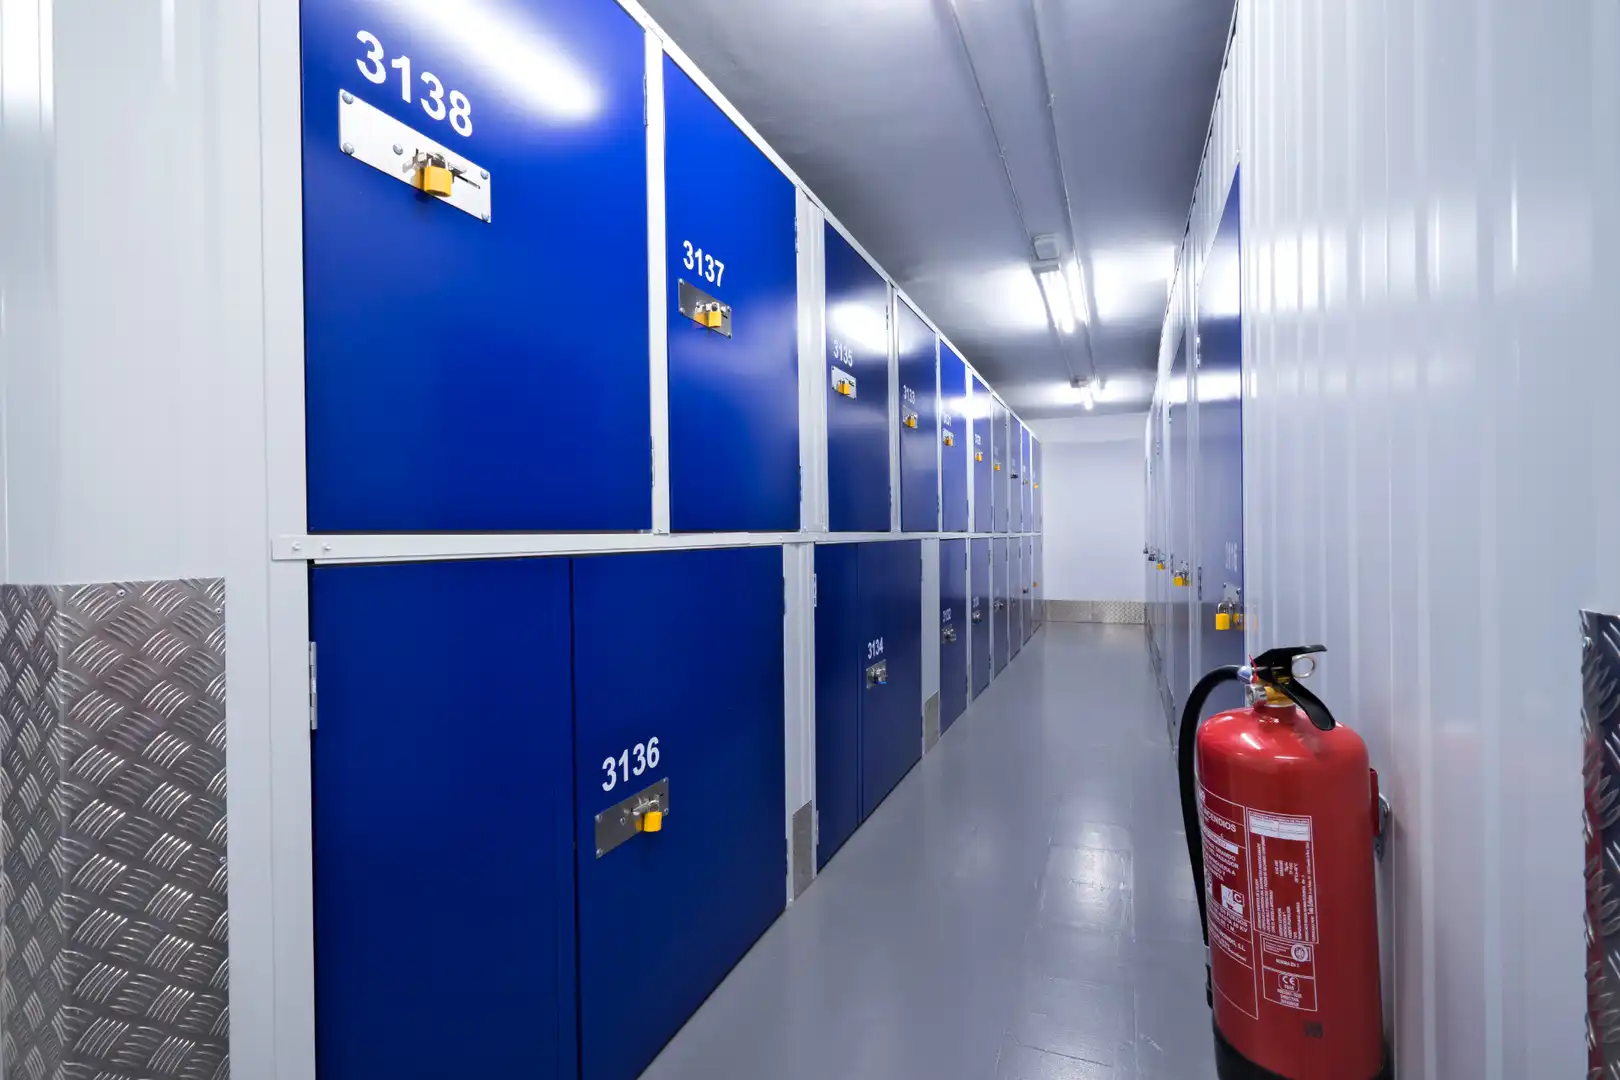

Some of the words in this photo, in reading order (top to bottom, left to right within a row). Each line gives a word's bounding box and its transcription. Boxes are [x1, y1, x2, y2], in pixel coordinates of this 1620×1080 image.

[356, 29, 473, 138] 3138
[682, 239, 725, 288] 3137
[833, 339, 853, 368] 3135
[903, 384, 916, 405] 3133
[867, 637, 884, 660] 3134
[601, 736, 660, 792] 3136
